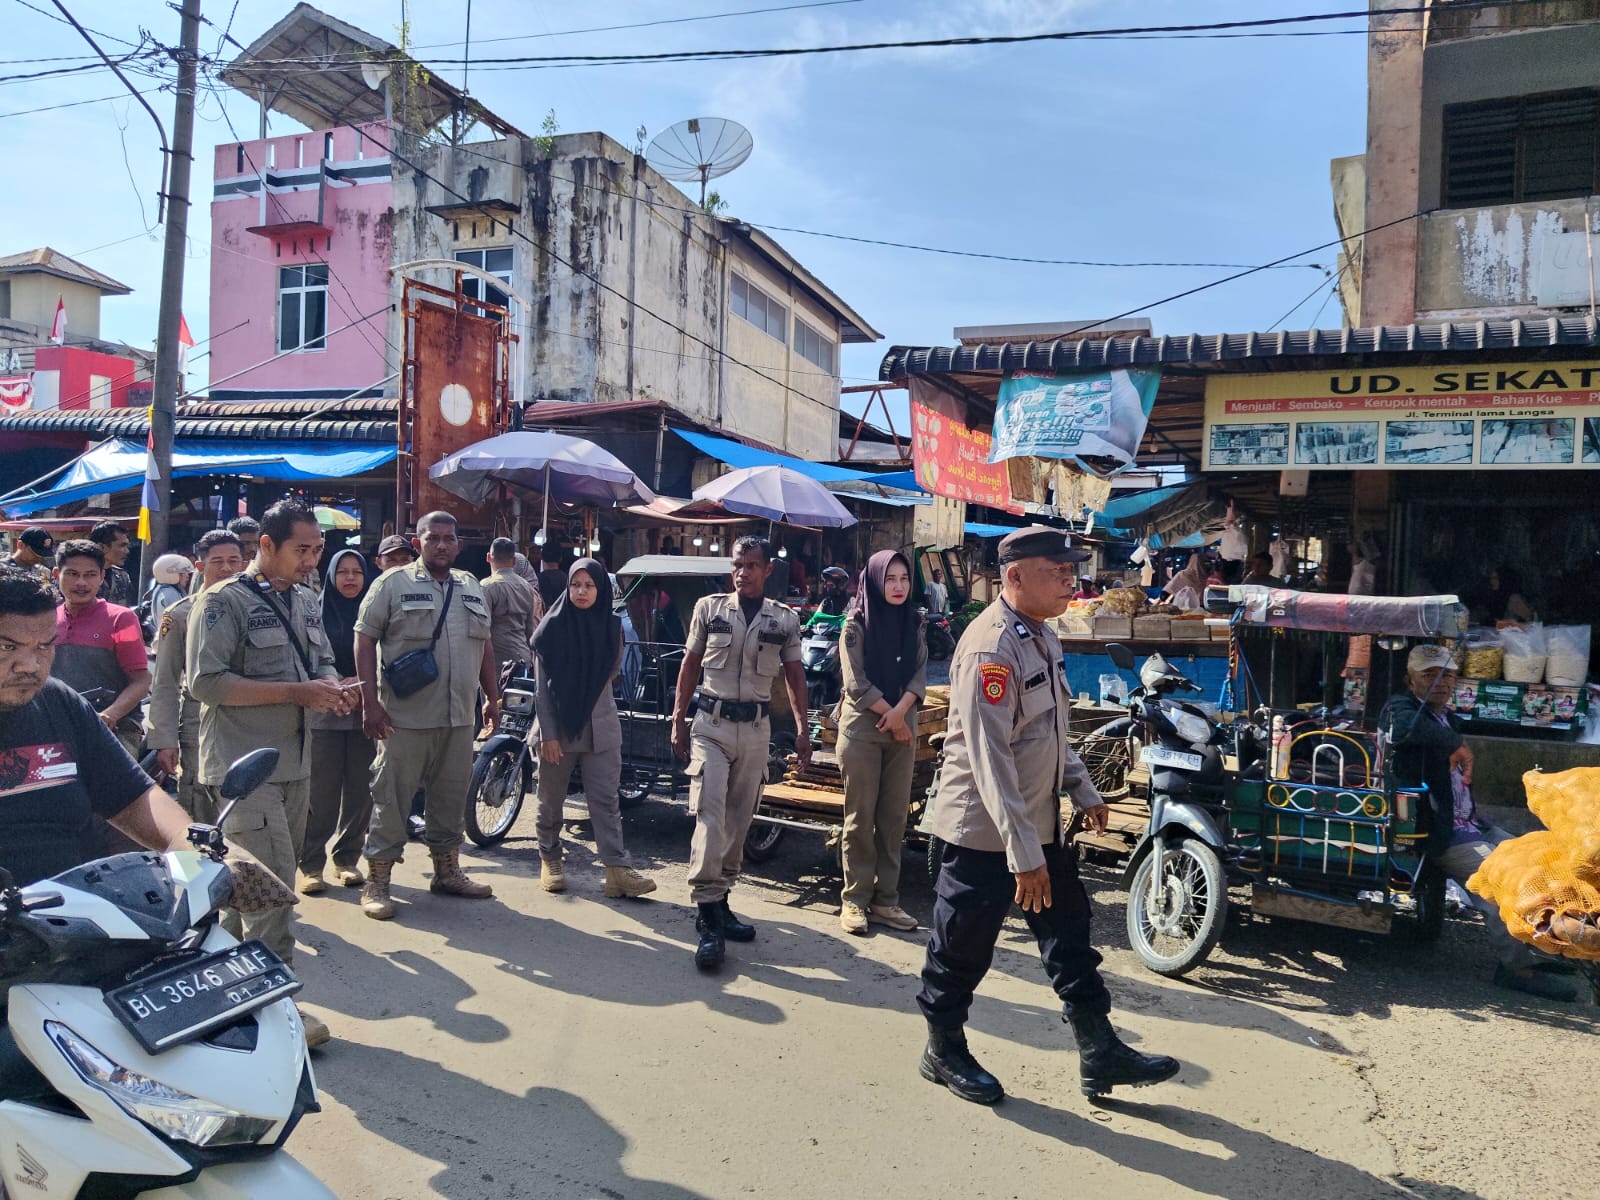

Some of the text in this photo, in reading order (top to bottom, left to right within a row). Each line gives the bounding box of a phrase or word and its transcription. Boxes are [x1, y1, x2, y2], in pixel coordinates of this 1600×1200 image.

[1330, 367, 1600, 395] UD. SEKAT
[1231, 400, 1281, 412] Menjual:
[1288, 399, 1343, 411] Sembako
[1364, 397, 1416, 410] Kerupuk
[1417, 395, 1467, 408] mentah
[1492, 394, 1533, 406] Bahan
[1535, 392, 1563, 405] Kue
[1422, 410, 1473, 418] Terminal
[1476, 409, 1506, 418] lama
[1508, 409, 1555, 418] Langsa
[128, 994, 167, 1020] BL
[162, 969, 224, 1004] 3646
[225, 950, 270, 978] NAF
